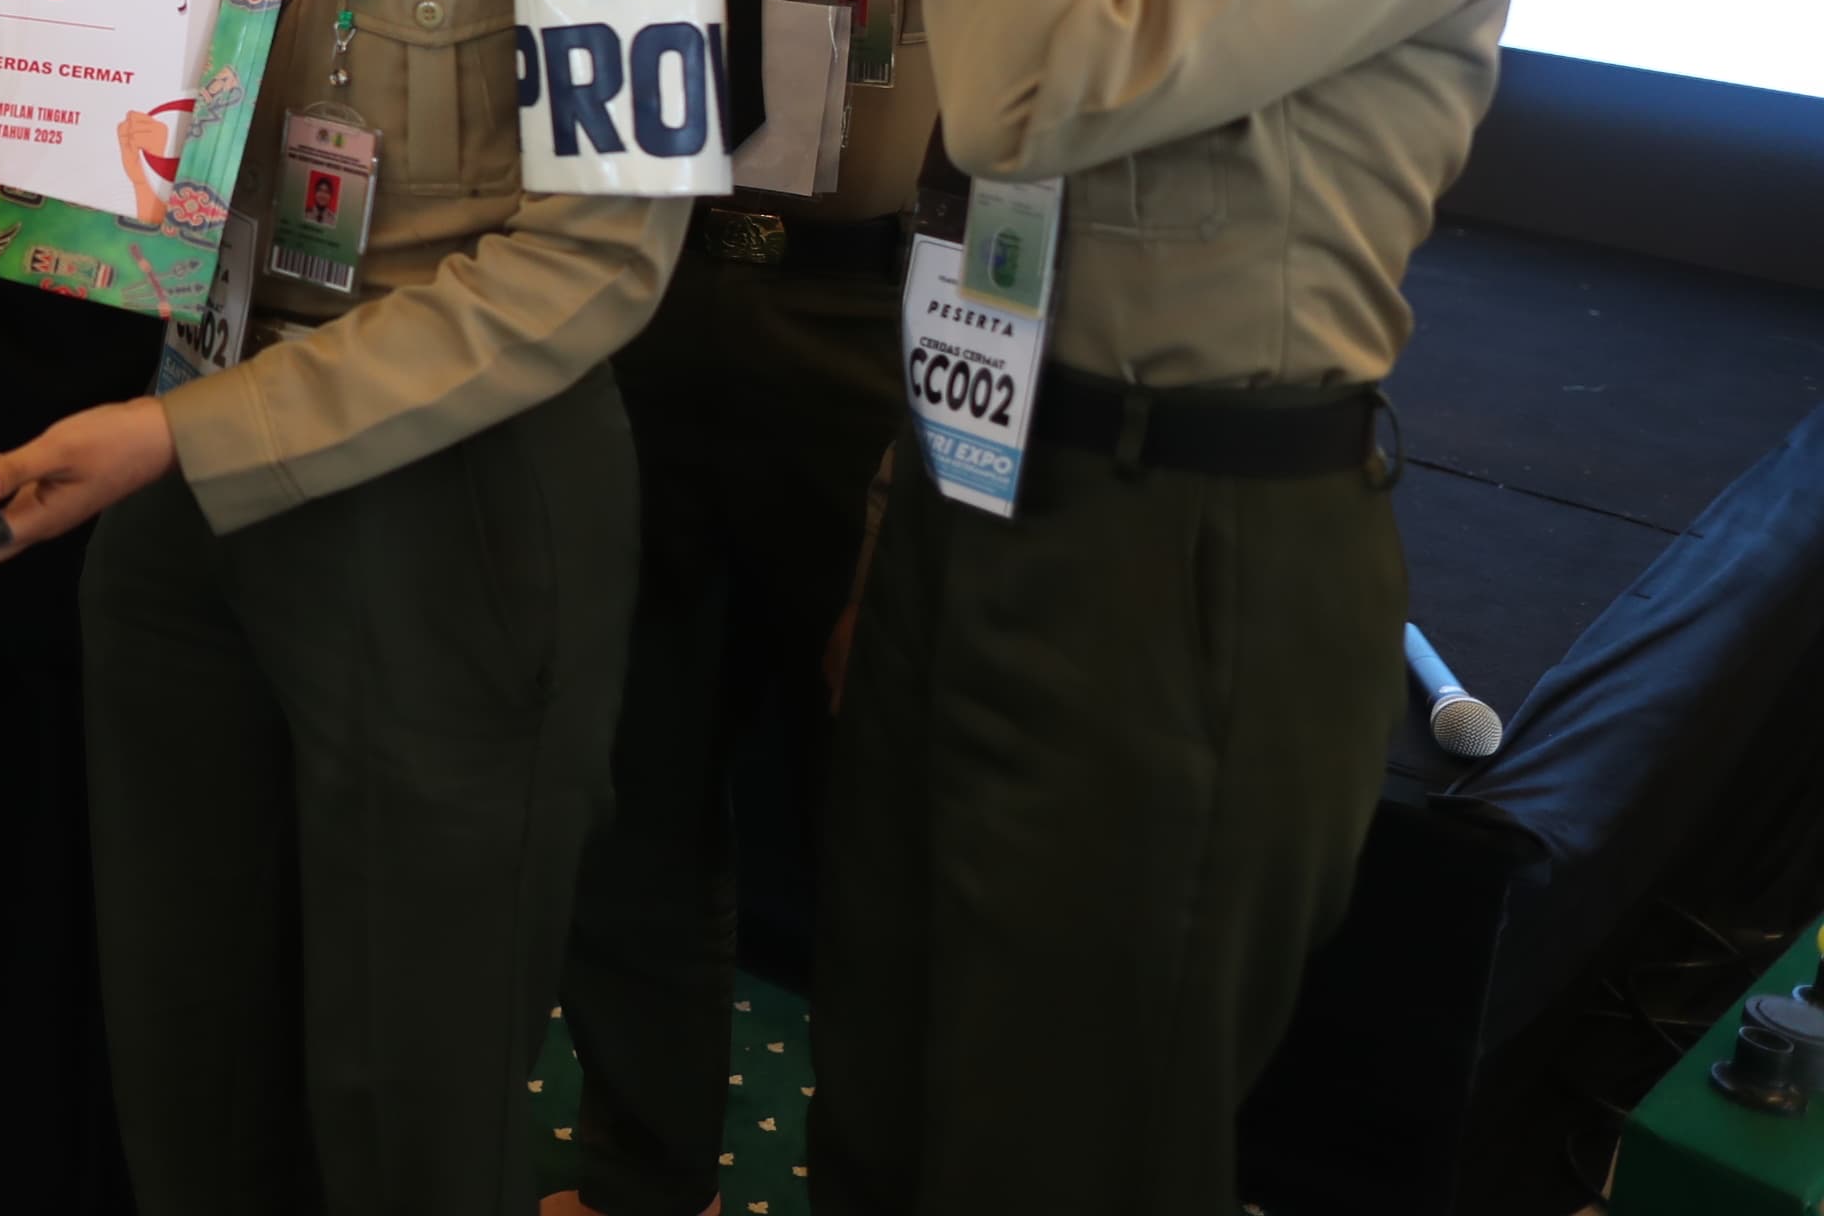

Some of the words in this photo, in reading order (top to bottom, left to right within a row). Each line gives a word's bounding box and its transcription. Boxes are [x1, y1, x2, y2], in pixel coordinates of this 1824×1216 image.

[58, 63, 135, 85] CERMAT
[37, 106, 81, 126] TINGKAT
[34, 127, 64, 145] 2025
[927, 299, 1015, 337] PESERTA
[919, 336, 961, 357] CERDAS
[909, 347, 1016, 427] CC002
[954, 441, 1012, 475] EXPO
